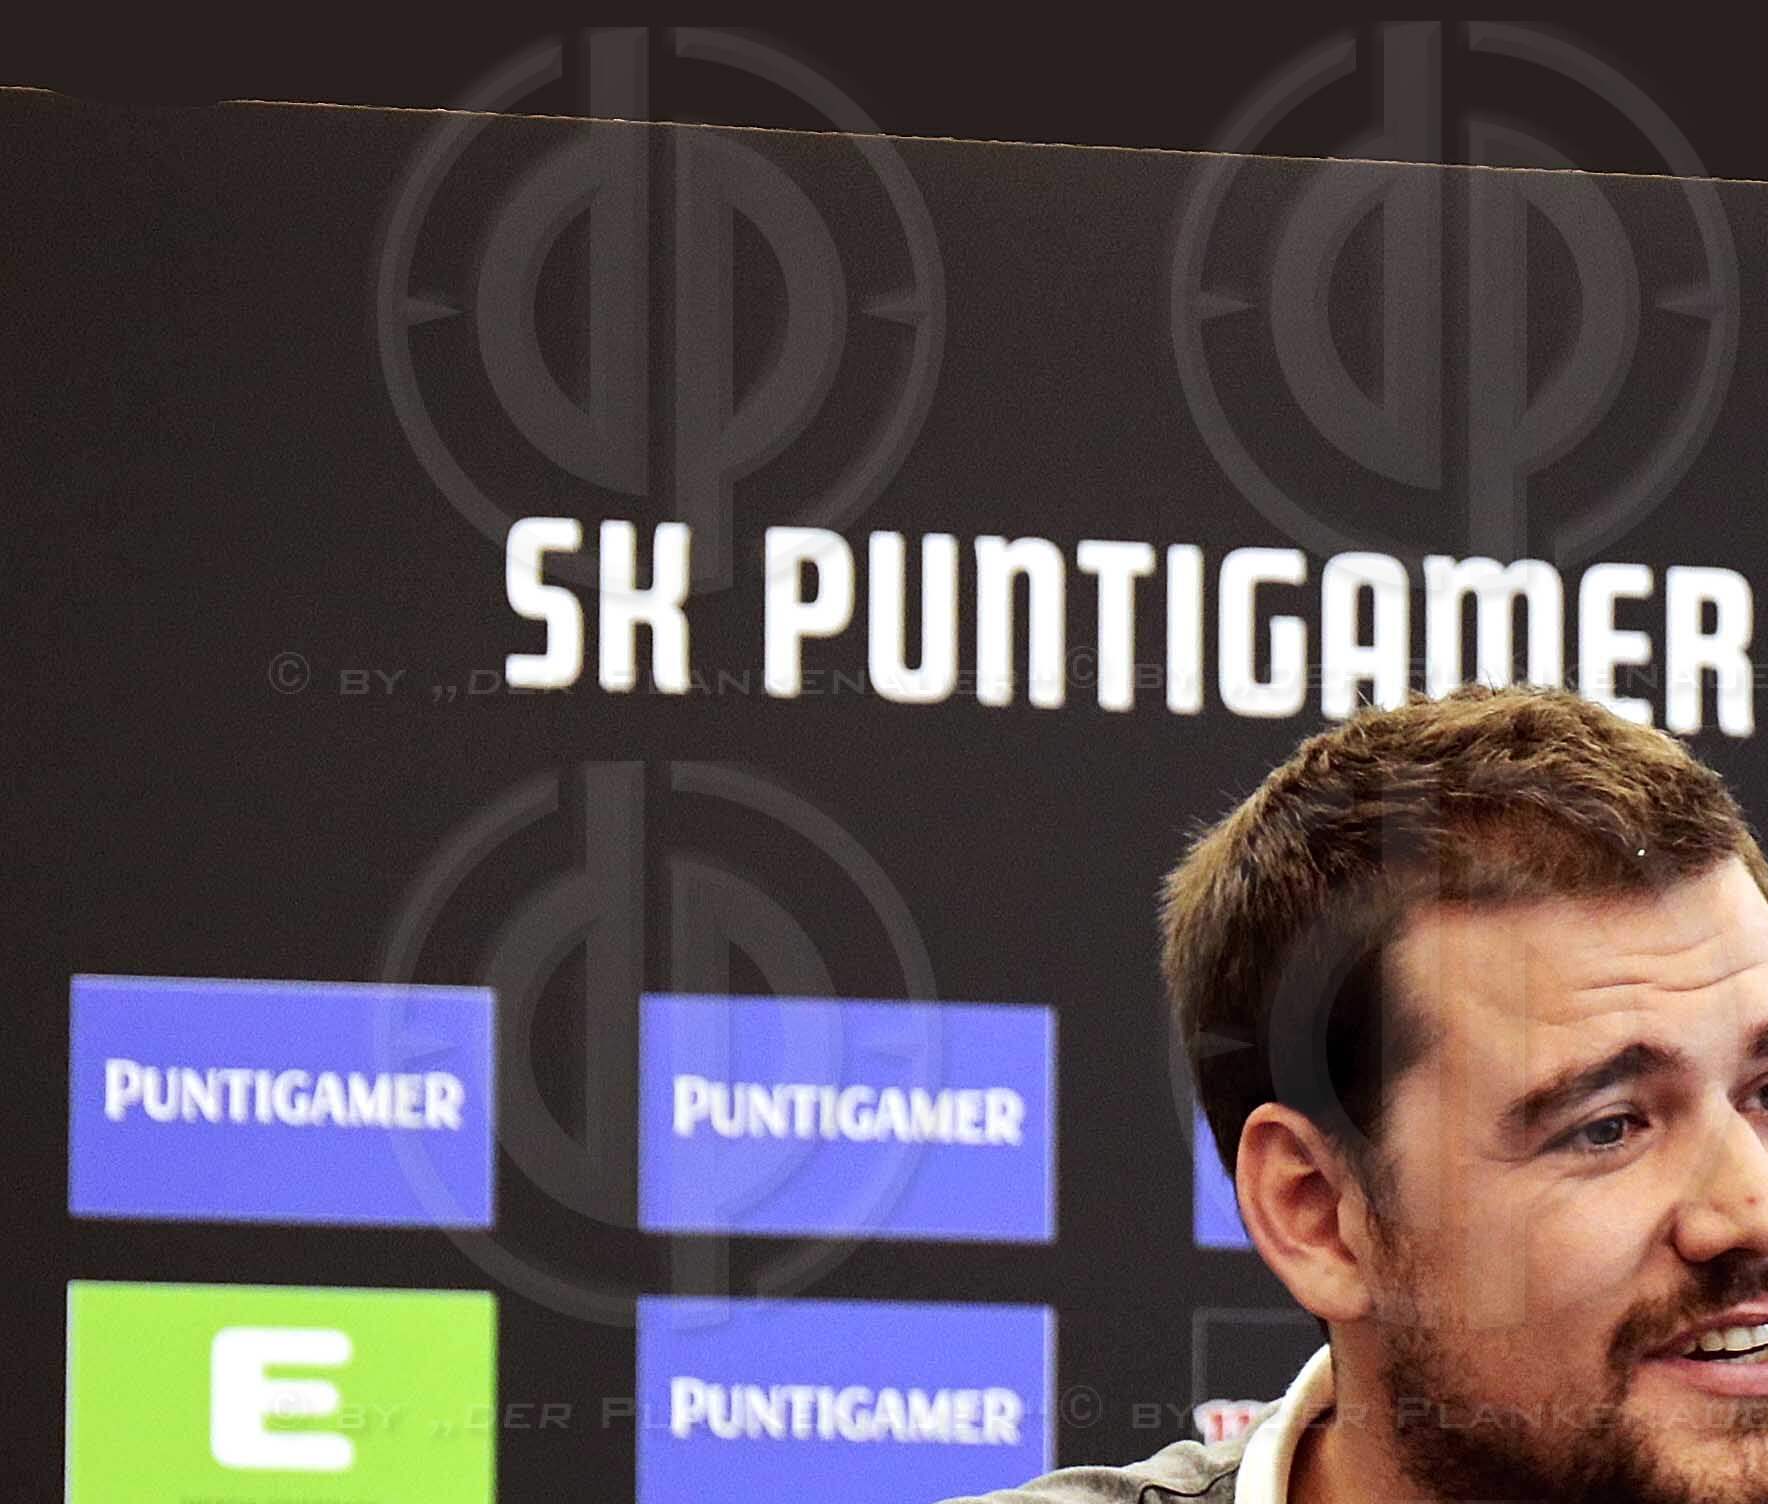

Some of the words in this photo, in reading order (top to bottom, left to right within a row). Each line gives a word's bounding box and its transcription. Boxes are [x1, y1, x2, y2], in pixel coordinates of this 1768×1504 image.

[505, 516, 691, 695] SK
[764, 526, 1755, 737] PUNTIGAMER
[105, 1057, 464, 1131] PUNTIGAMER
[672, 1073, 1024, 1146] PUNTIGAMER
[670, 1375, 1022, 1446] PUNTIGAMER
